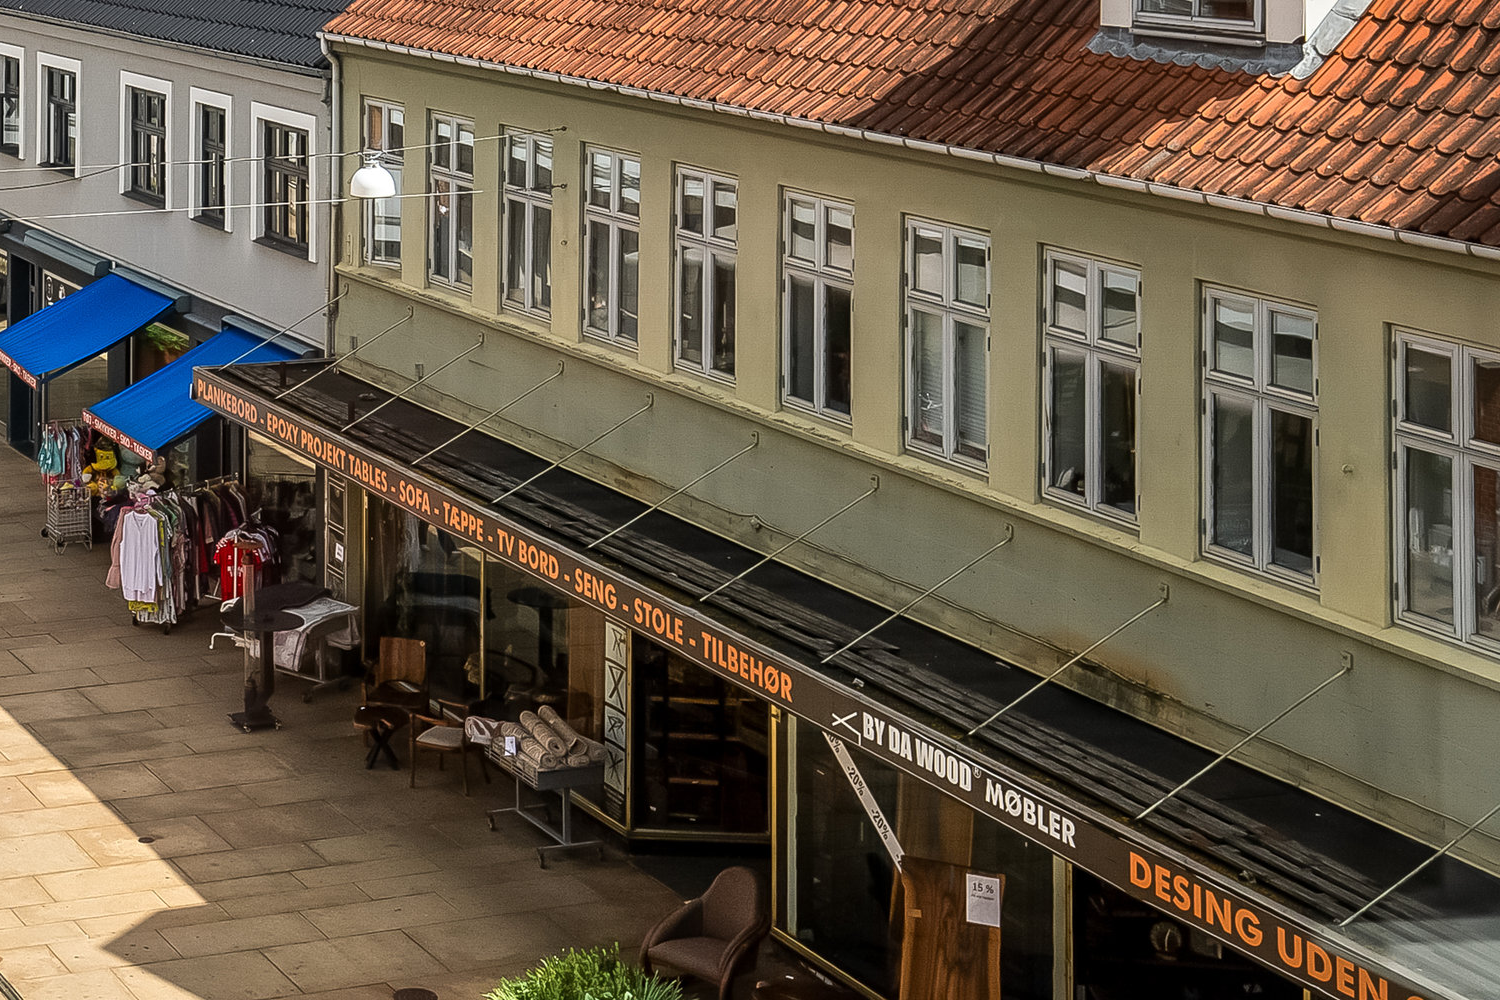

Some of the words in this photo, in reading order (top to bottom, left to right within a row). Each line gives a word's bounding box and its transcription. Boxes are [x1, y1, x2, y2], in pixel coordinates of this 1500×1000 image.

[197, 378, 258, 424] PLANKEBORD
[267, 412, 300, 445] EPOXY
[301, 429, 346, 471] PROJEKT
[348, 453, 388, 492] TABLES
[399, 479, 431, 516] SOFA
[442, 501, 484, 542] TÆPPE
[497, 528, 515, 557] TV
[518, 539, 559, 580] BORD
[574, 567, 618, 610] SENG
[633, 597, 684, 645] STOLE
[701, 631, 793, 703] TILBEHØR
[847, 765, 864, 797] -20%
[862, 711, 885, 746] BY
[888, 724, 913, 762] DA
[985, 777, 1076, 848] MØBLER
[871, 808, 889, 841] -20%
[972, 882, 984, 892] 15
[1129, 851, 1264, 947] DESING
[1276, 927, 1388, 1000] UDEN
